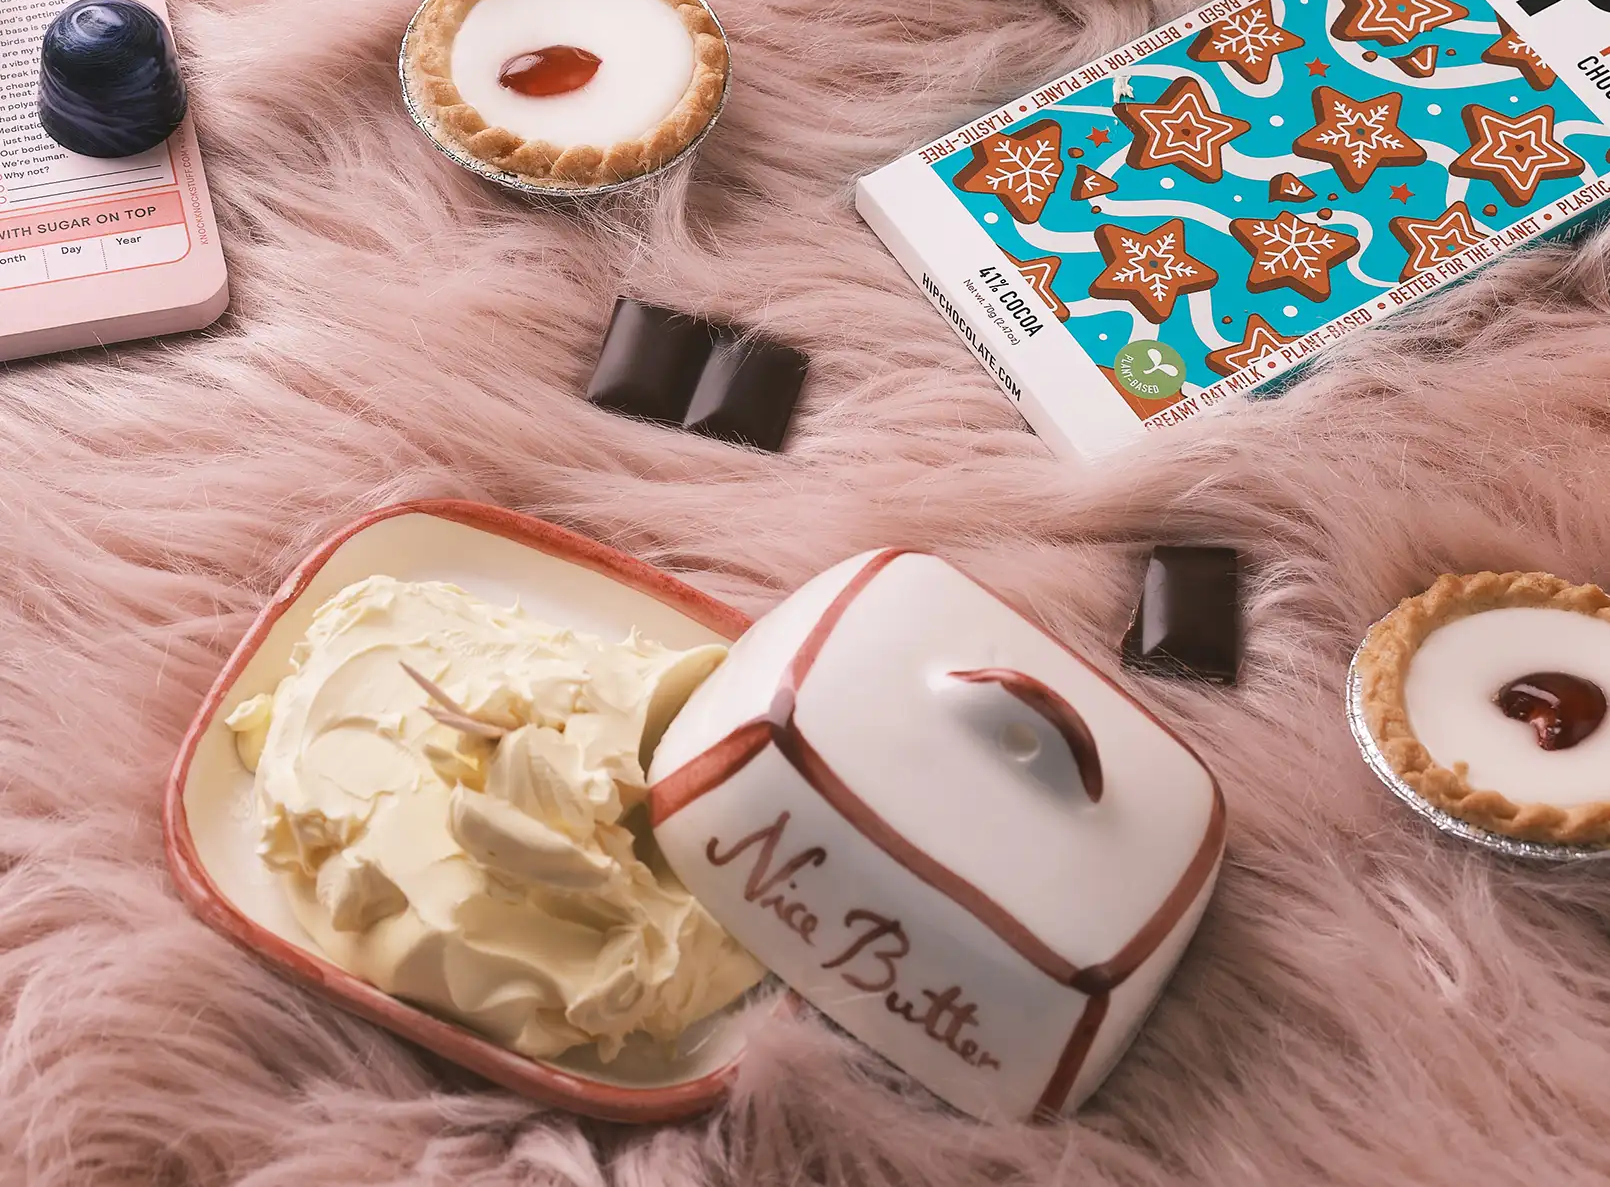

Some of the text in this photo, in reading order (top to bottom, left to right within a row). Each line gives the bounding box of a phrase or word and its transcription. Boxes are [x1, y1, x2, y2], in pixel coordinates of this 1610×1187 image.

[0, 4, 28, 15] rents
[30, 1, 46, 10] are
[5, 27, 29, 36] base
[30, 23, 39, 31] is
[0, 37, 26, 47] birds
[1132, 26, 1182, 57] BETTER
[2, 50, 19, 58] are
[20, 47, 34, 55] my
[1105, 49, 1135, 71] FOR
[9, 59, 30, 68] vibe
[0, 70, 29, 81] break
[1079, 64, 1108, 85] THE
[1577, 56, 1610, 100] CHO
[9, 89, 35, 99] heat.
[1031, 76, 1078, 110] PLANET
[2, 137, 23, 146] just
[24, 132, 43, 142] had
[918, 111, 1014, 165] PLASTIC-FREE
[0, 142, 55, 157] Our bodies
[2, 152, 69, 168] We're human.
[4, 165, 50, 180] Why not?
[180, 150, 208, 245] KNOCKKNOCKSTUFF.COM
[37, 216, 92, 234] SUGAR
[96, 211, 120, 225] ON
[124, 205, 157, 220] TOP
[61, 245, 83, 256] Day
[115, 234, 142, 246] Year
[963, 278, 1021, 346] Net wt. 70g (2.47oz)
[979, 266, 1044, 337] 41% COCOA
[1144, 398, 1201, 432] CREAMY
[1200, 384, 1227, 406] OAT
[1280, 308, 1373, 364] PLANT-BASED
[1388, 272, 1441, 306] BETTER
[1437, 257, 1470, 280] FOR
[1464, 243, 1494, 266] THE
[1493, 217, 1542, 252] PLANET
[922, 272, 1022, 402] HIPCHOCOLATE.COM
[1120, 354, 1160, 394] PLANT-BASED
[706, 810, 1001, 1071] Nice Butter
